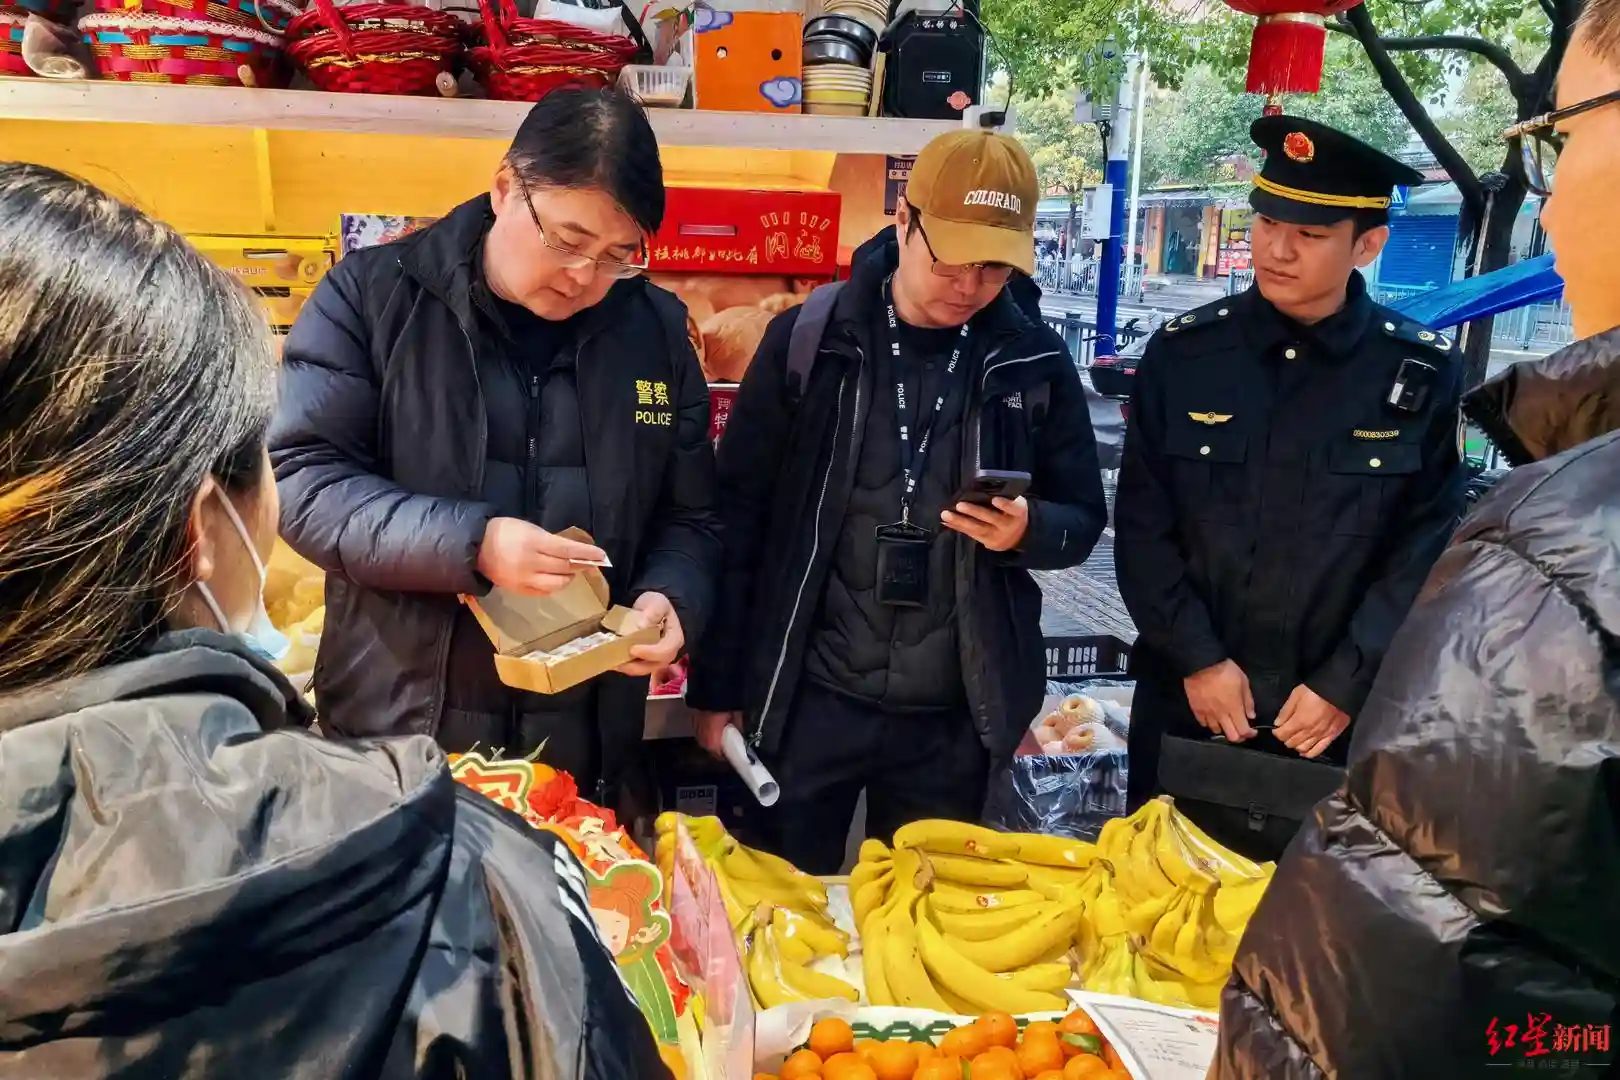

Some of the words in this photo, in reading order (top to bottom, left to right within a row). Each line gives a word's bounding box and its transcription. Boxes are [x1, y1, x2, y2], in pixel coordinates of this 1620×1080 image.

[964, 189, 1020, 214] COLORADO
[887, 304, 896, 328] POLICE
[948, 348, 960, 373] POLICE
[636, 380, 669, 405] 警察
[897, 383, 906, 409] POLICE
[635, 411, 672, 426] POLICE
